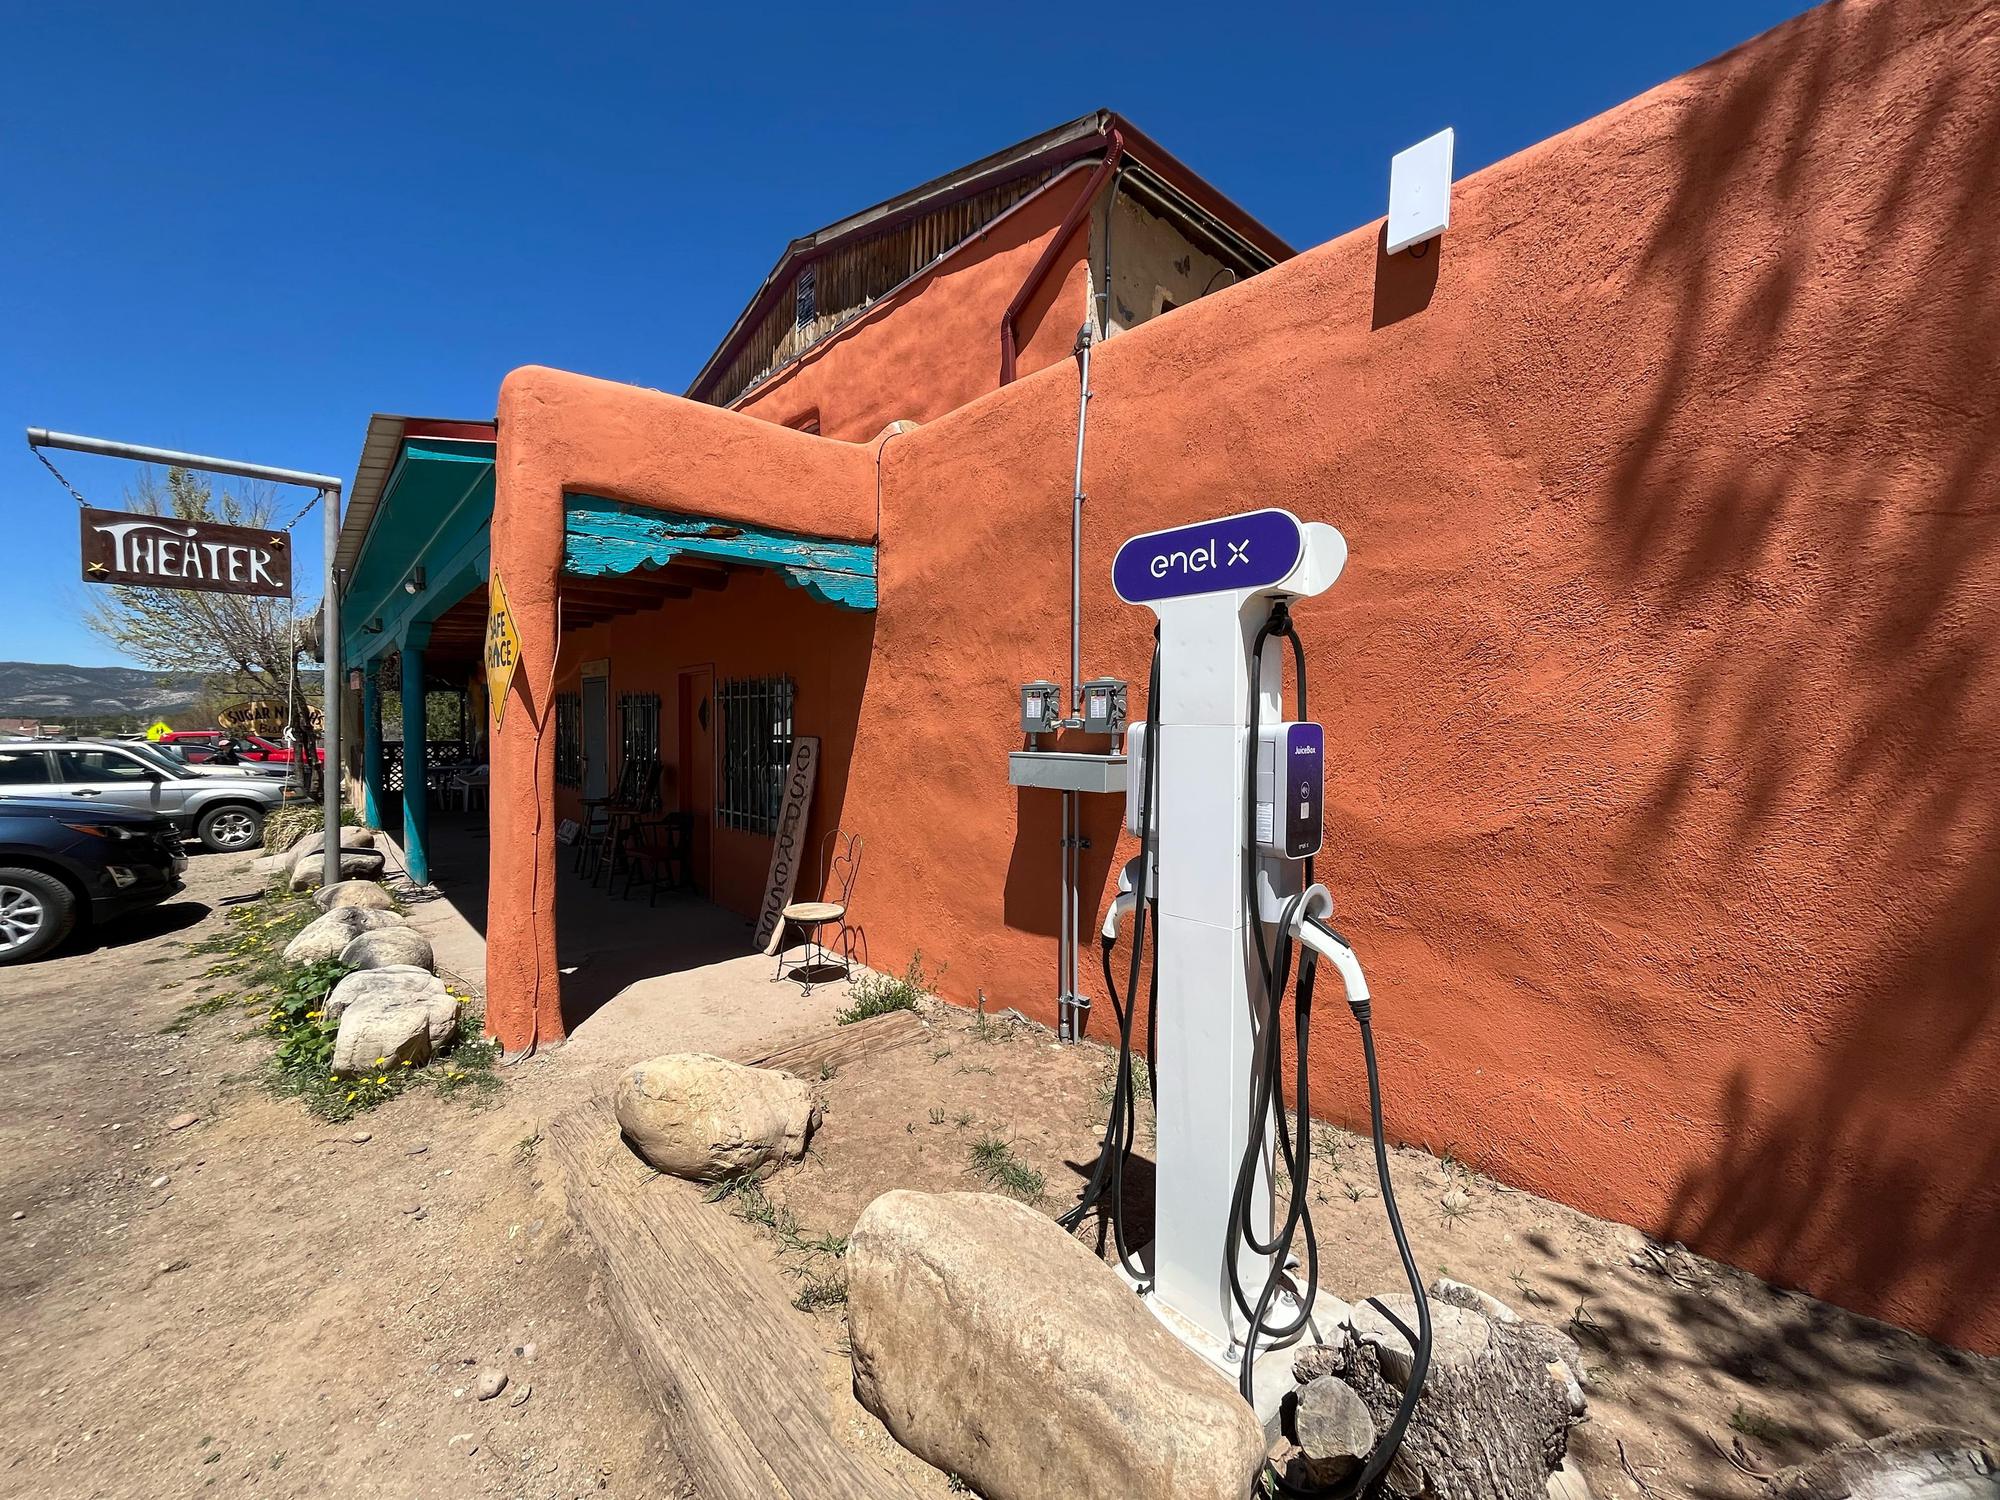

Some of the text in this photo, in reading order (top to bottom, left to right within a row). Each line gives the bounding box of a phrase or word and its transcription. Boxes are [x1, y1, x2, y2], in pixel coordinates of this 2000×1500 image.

[93, 523, 284, 587] THEATER
[1150, 538, 1217, 578] enel
[489, 611, 506, 641] SAFE
[227, 707, 270, 724] SUGAR
[1295, 745, 1316, 755] JuiceBox
